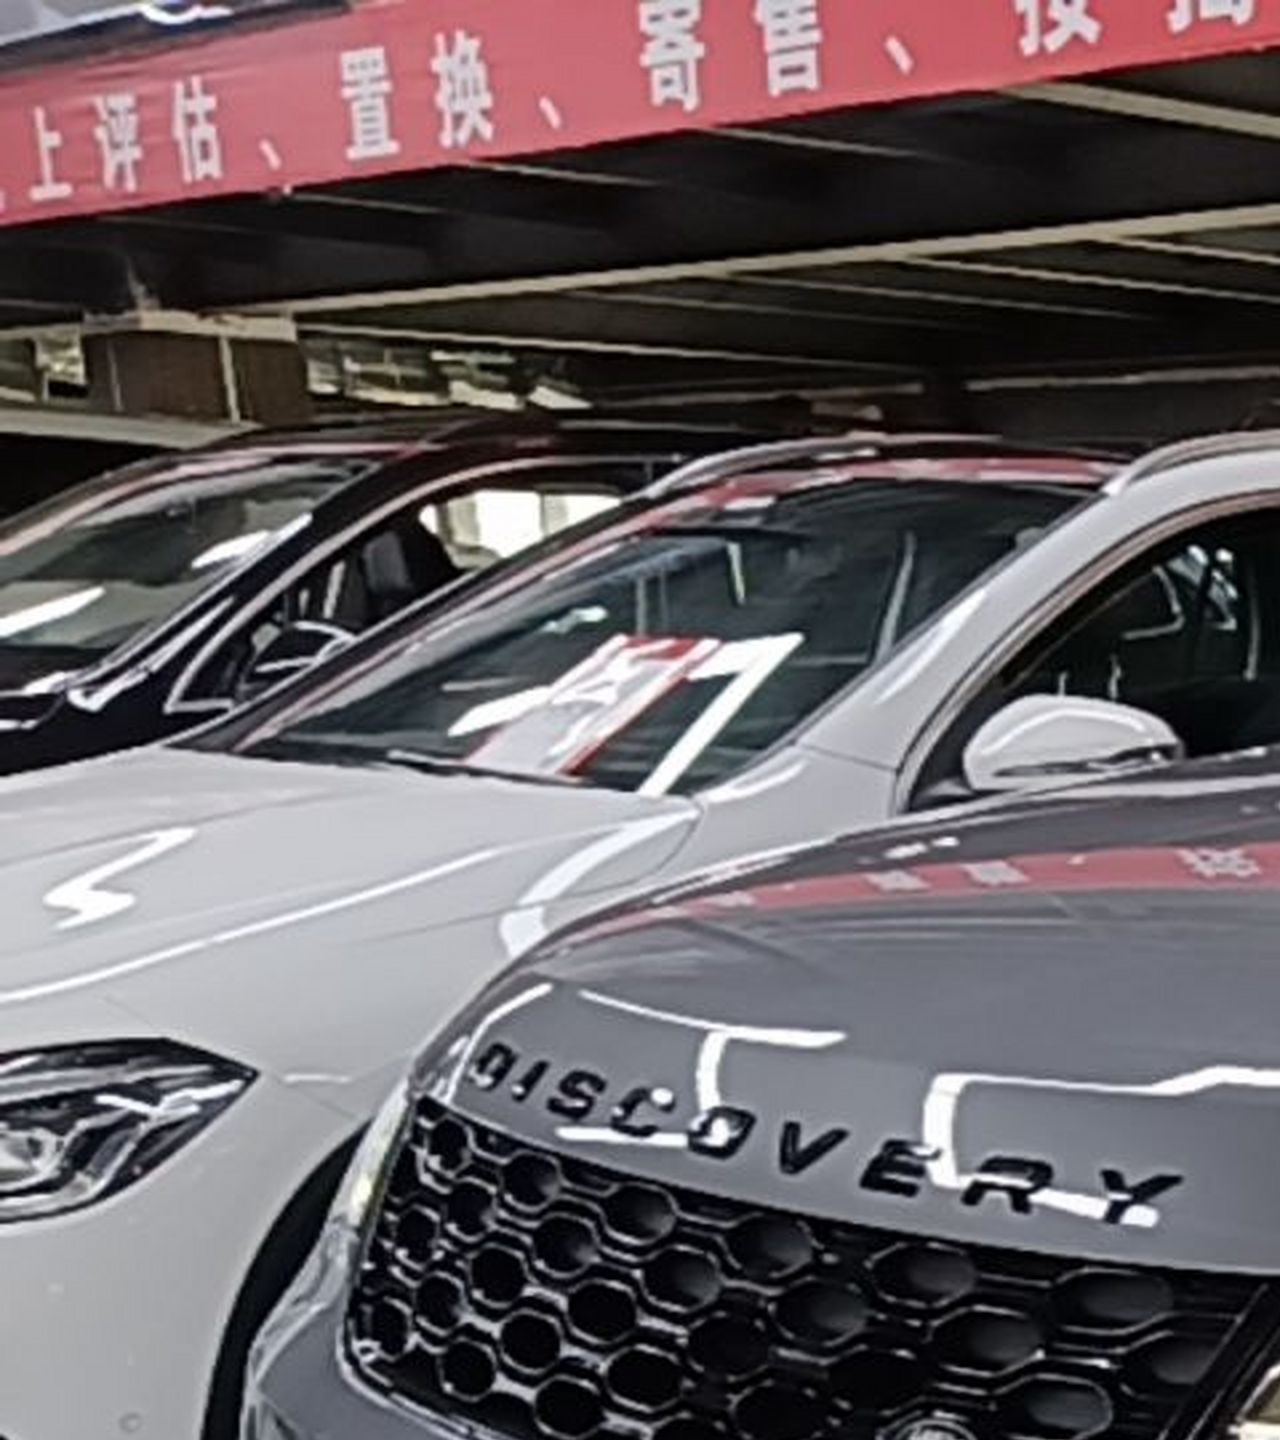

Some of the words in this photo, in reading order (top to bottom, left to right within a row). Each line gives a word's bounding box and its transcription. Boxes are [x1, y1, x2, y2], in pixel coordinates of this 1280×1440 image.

[29, 0, 1255, 200] 上评估、置换、寄售、
[470, 1042, 1184, 1224] DISCOVERY
